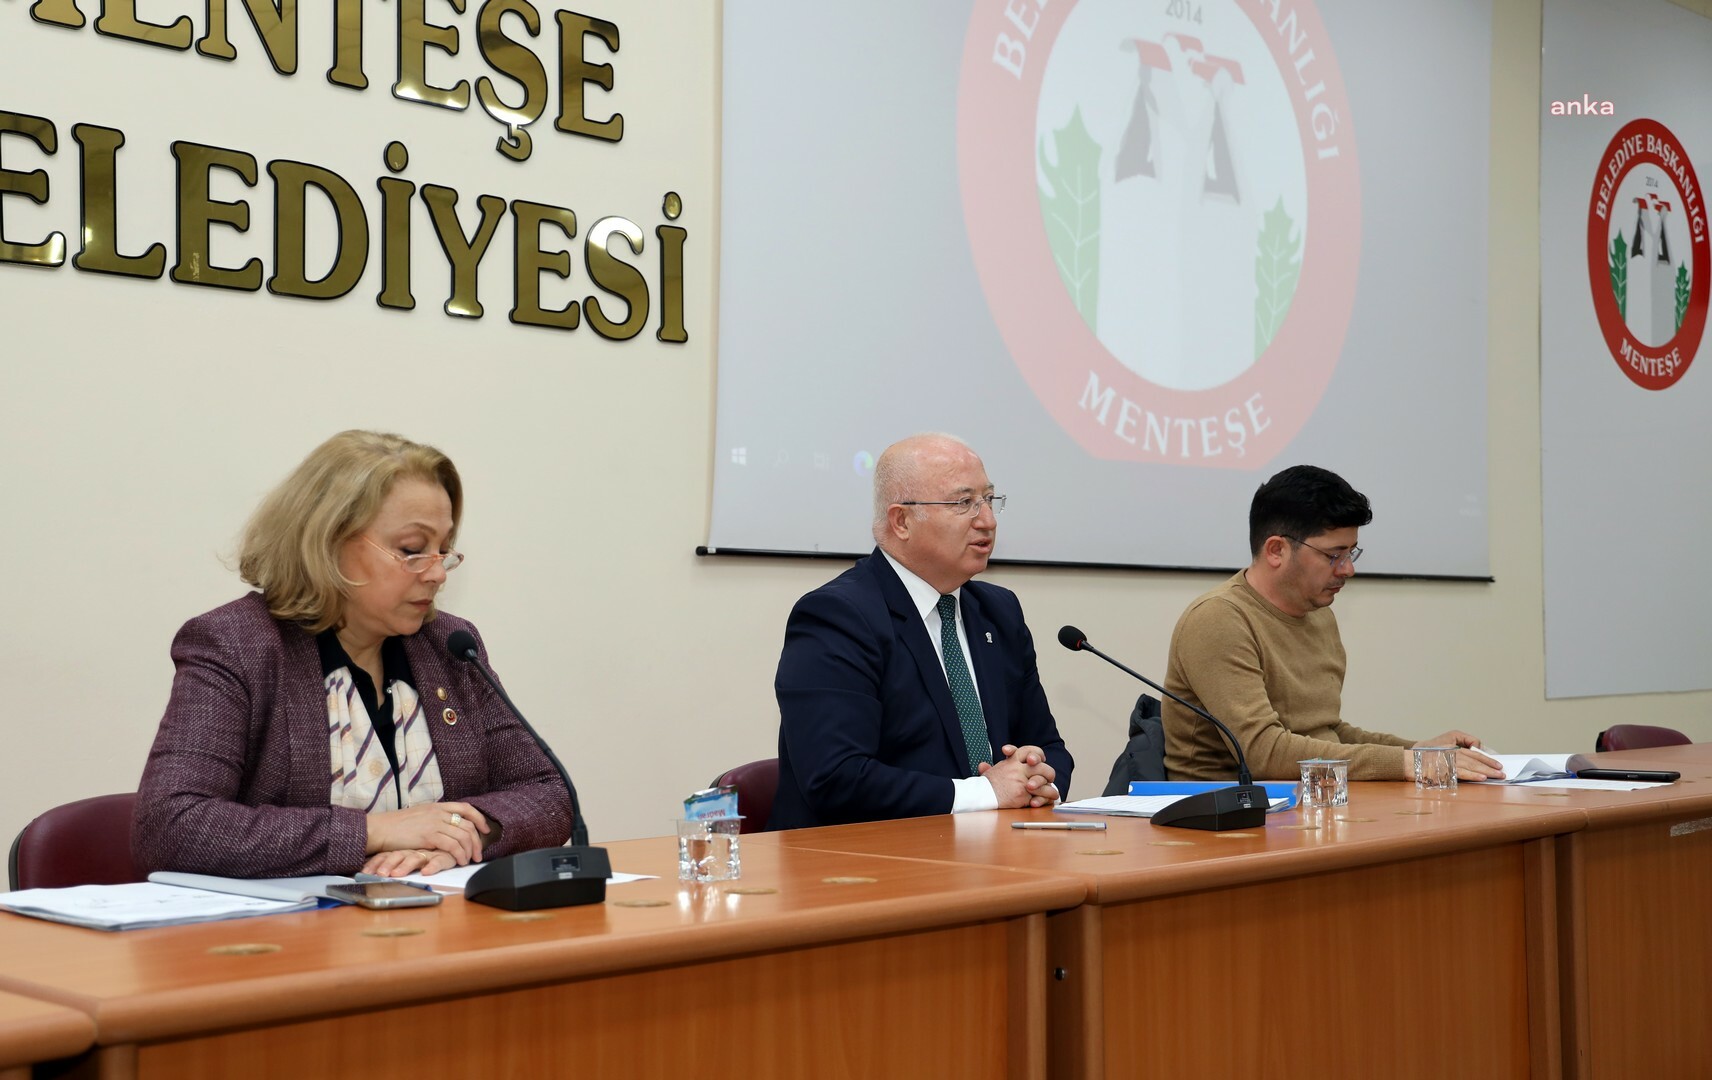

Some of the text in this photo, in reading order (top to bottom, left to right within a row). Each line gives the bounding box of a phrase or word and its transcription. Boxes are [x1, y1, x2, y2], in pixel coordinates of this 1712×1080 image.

[1165, 0, 1203, 25] 2014
[1596, 133, 1705, 243] BELEDİYE BAŞKANLIĞI
[1620, 338, 1682, 377] MENTEŞE
[1078, 369, 1272, 459] MENTEŞE
